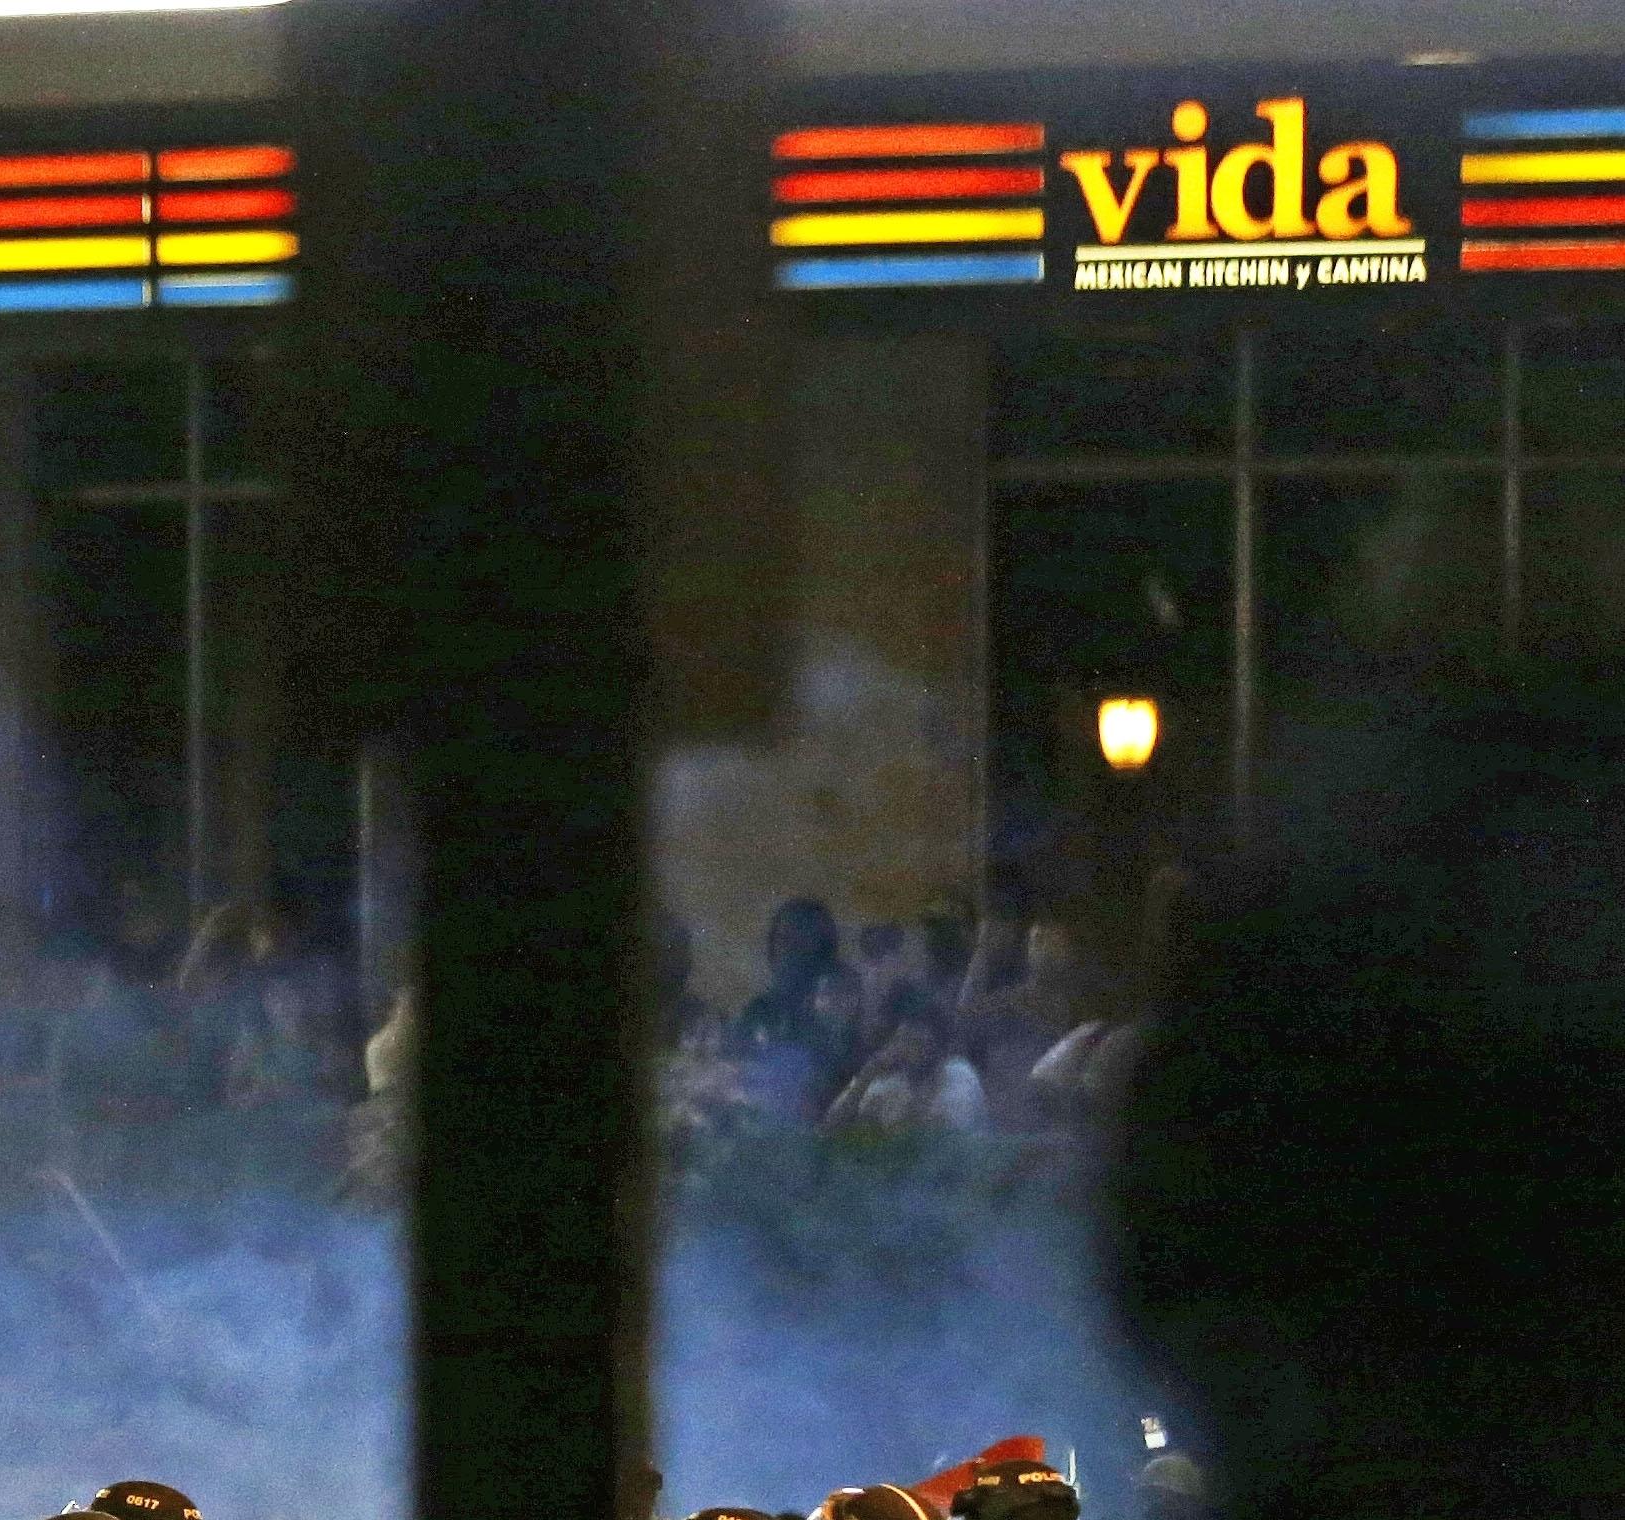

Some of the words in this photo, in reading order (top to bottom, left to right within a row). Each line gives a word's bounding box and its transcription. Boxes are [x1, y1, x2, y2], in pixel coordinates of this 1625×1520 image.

[1060, 96, 1414, 246] vida
[1074, 260, 1182, 290] MEXICAN
[1189, 257, 1289, 288] KITCHEN
[1317, 254, 1428, 284] CANTINA
